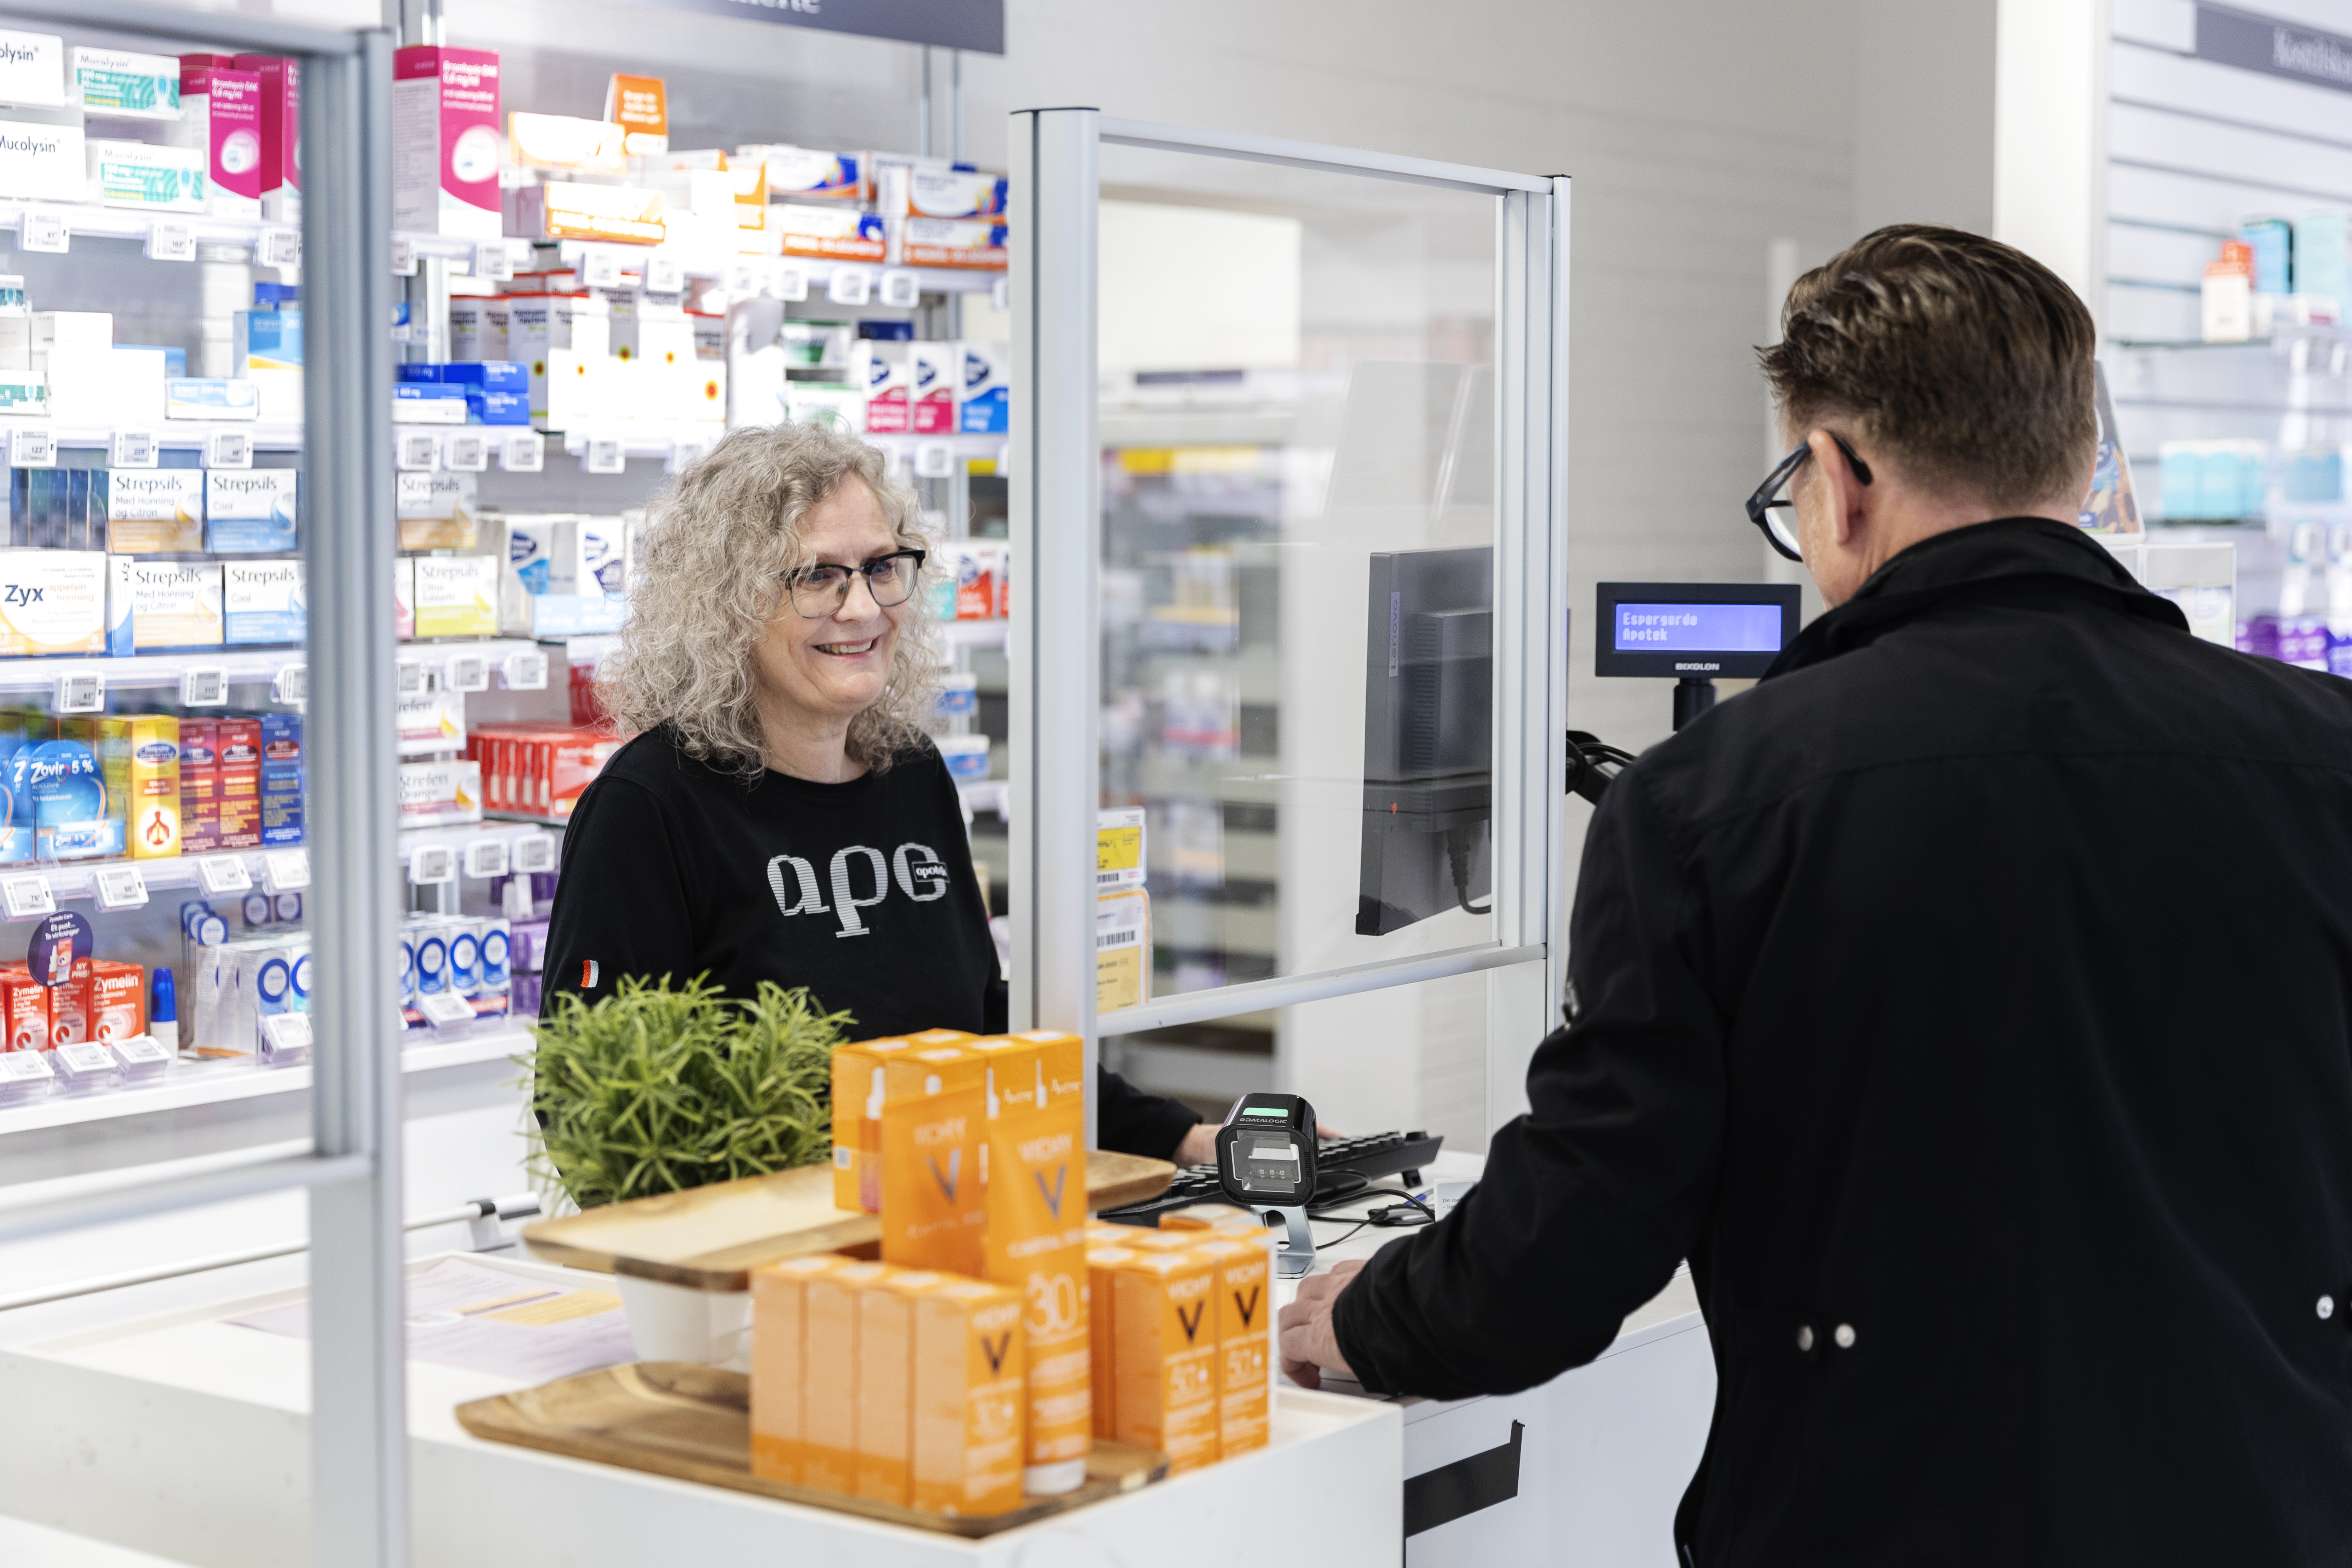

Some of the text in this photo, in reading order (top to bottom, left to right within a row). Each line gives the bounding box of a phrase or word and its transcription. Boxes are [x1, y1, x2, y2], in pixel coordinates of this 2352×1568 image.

[116, 475, 182, 494] Strepsils
[214, 475, 277, 493] Strepsils
[138, 496, 174, 506] Honning
[213, 501, 233, 511] Cool
[130, 507, 157, 518] Citron
[136, 568, 202, 587] Strepsils
[231, 567, 294, 586] Strepsils
[48, 583, 86, 593] appelsin
[157, 589, 194, 599] Honning
[5, 584, 44, 607] Zyx
[57, 594, 94, 602] honning
[231, 593, 251, 603] Cool
[1622, 627, 1668, 641] Apotek
[1675, 662, 1720, 671] BIXOLON
[30, 761, 64, 784] Zovir
[71, 760, 80, 774] 5
[82, 759, 94, 773] %
[76, 962, 87, 970] NY
[93, 973, 139, 993] Zymelin
[13, 985, 44, 997] Zymelin
[1023, 1271, 1079, 1335] 30
